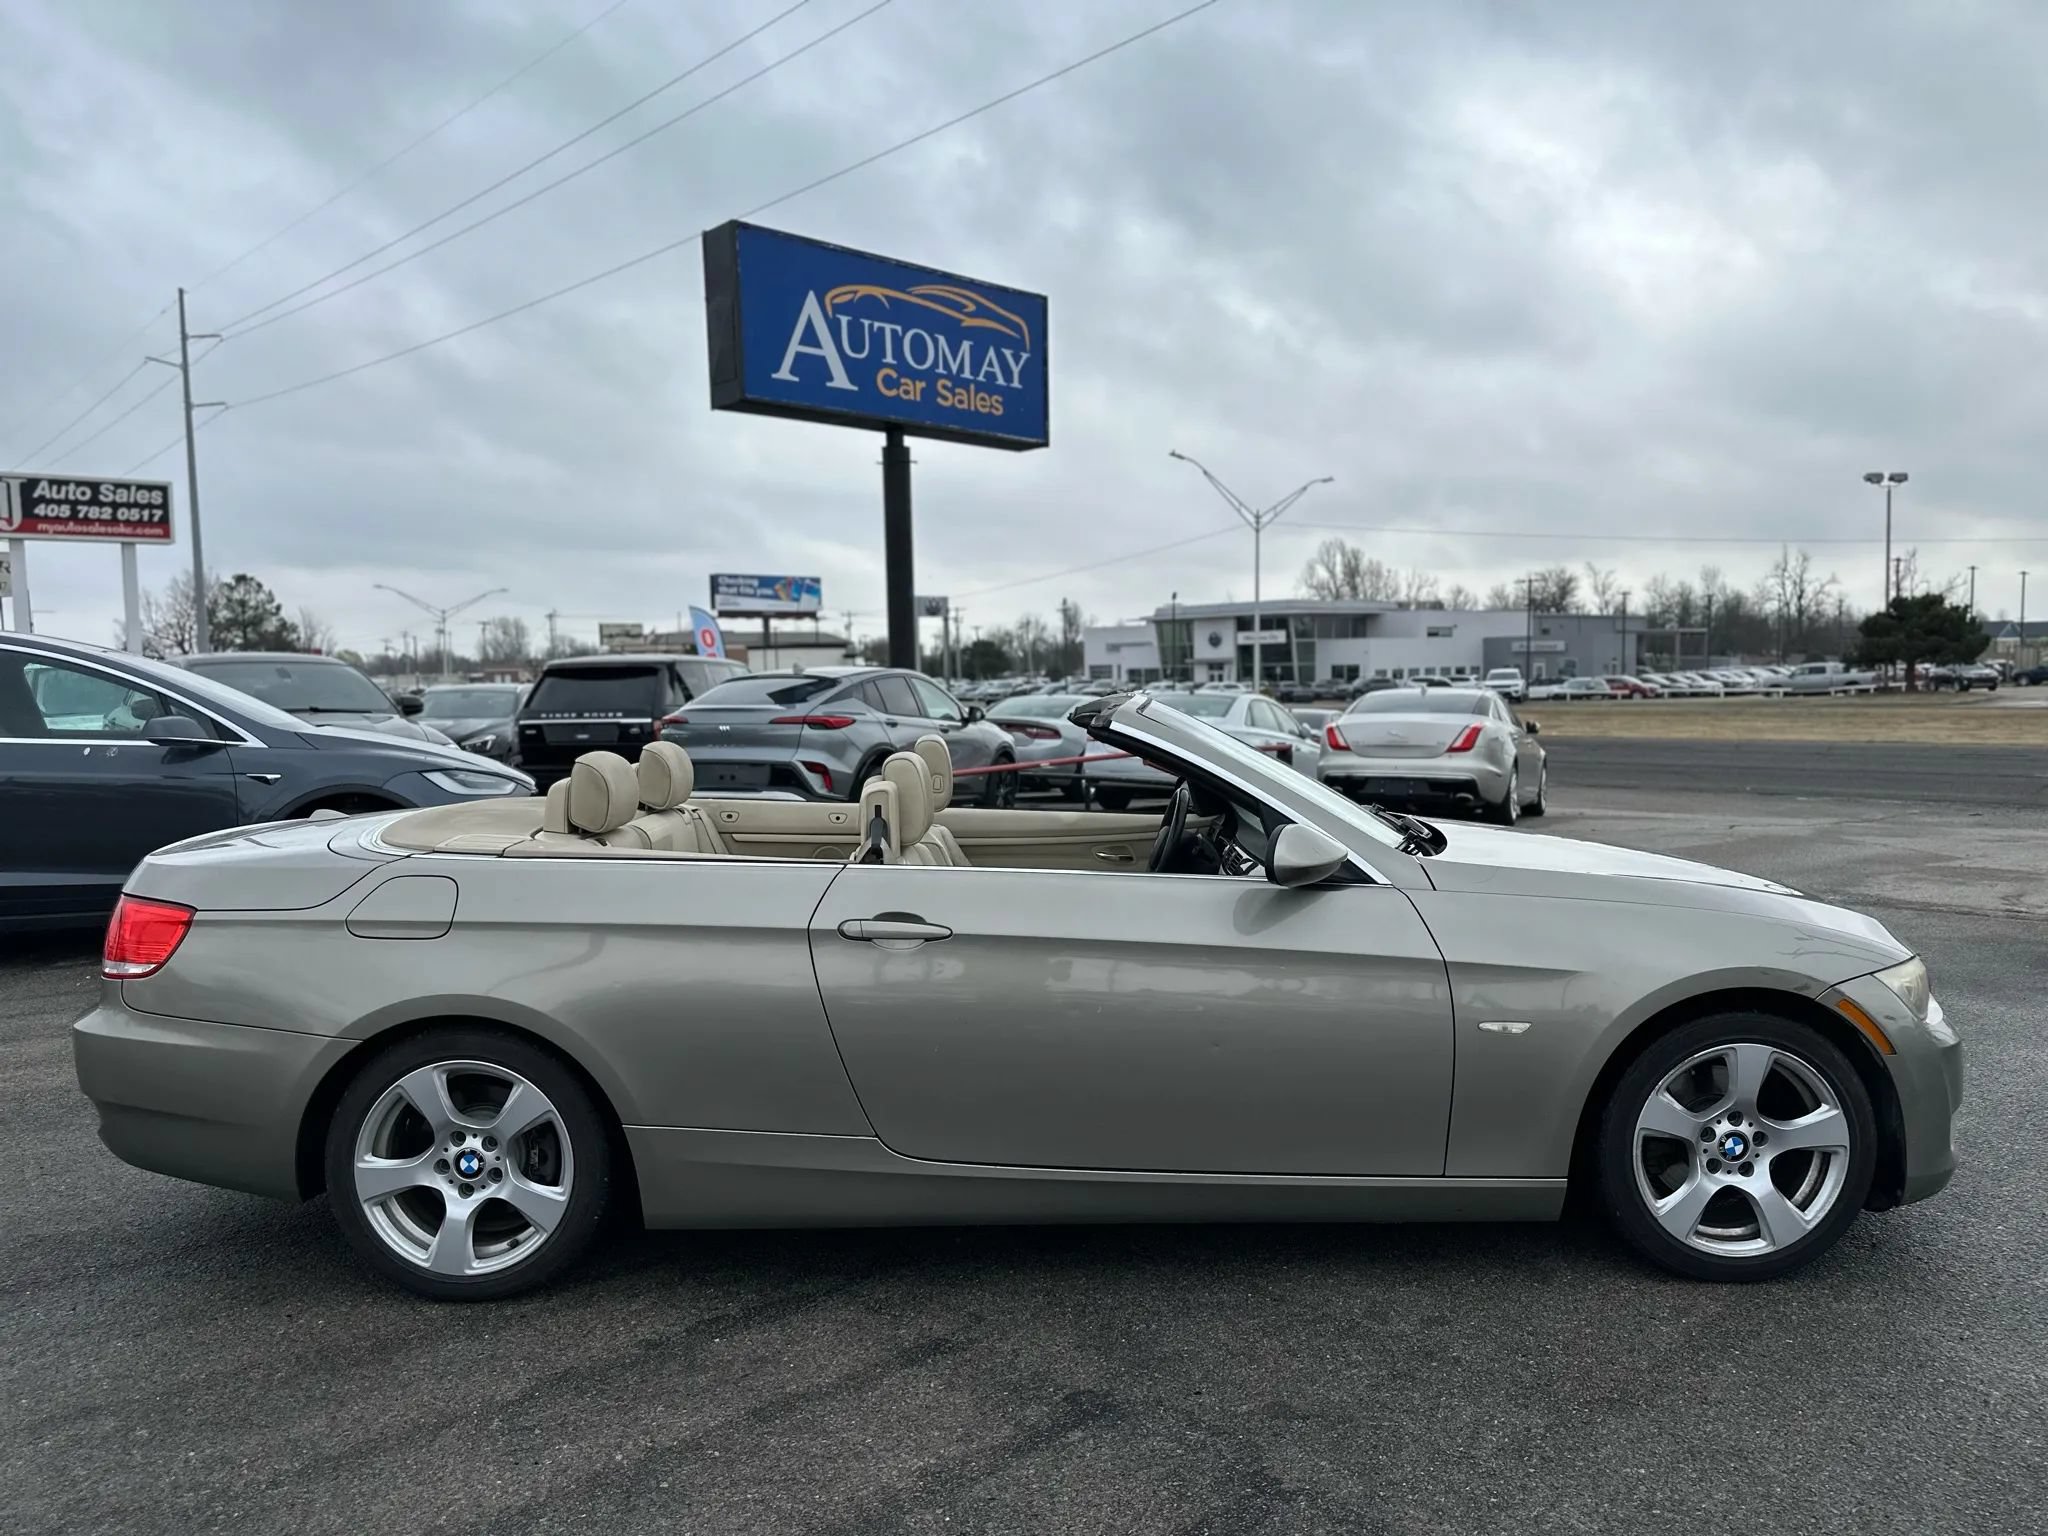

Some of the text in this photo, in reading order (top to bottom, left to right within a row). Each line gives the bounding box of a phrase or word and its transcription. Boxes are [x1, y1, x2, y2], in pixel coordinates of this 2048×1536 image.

[771, 290, 1031, 391] AUTOMAY
[876, 367, 1004, 416] Car Sales
[32, 479, 164, 505] Auto Sales
[33, 503, 164, 522] 405 782 0517
